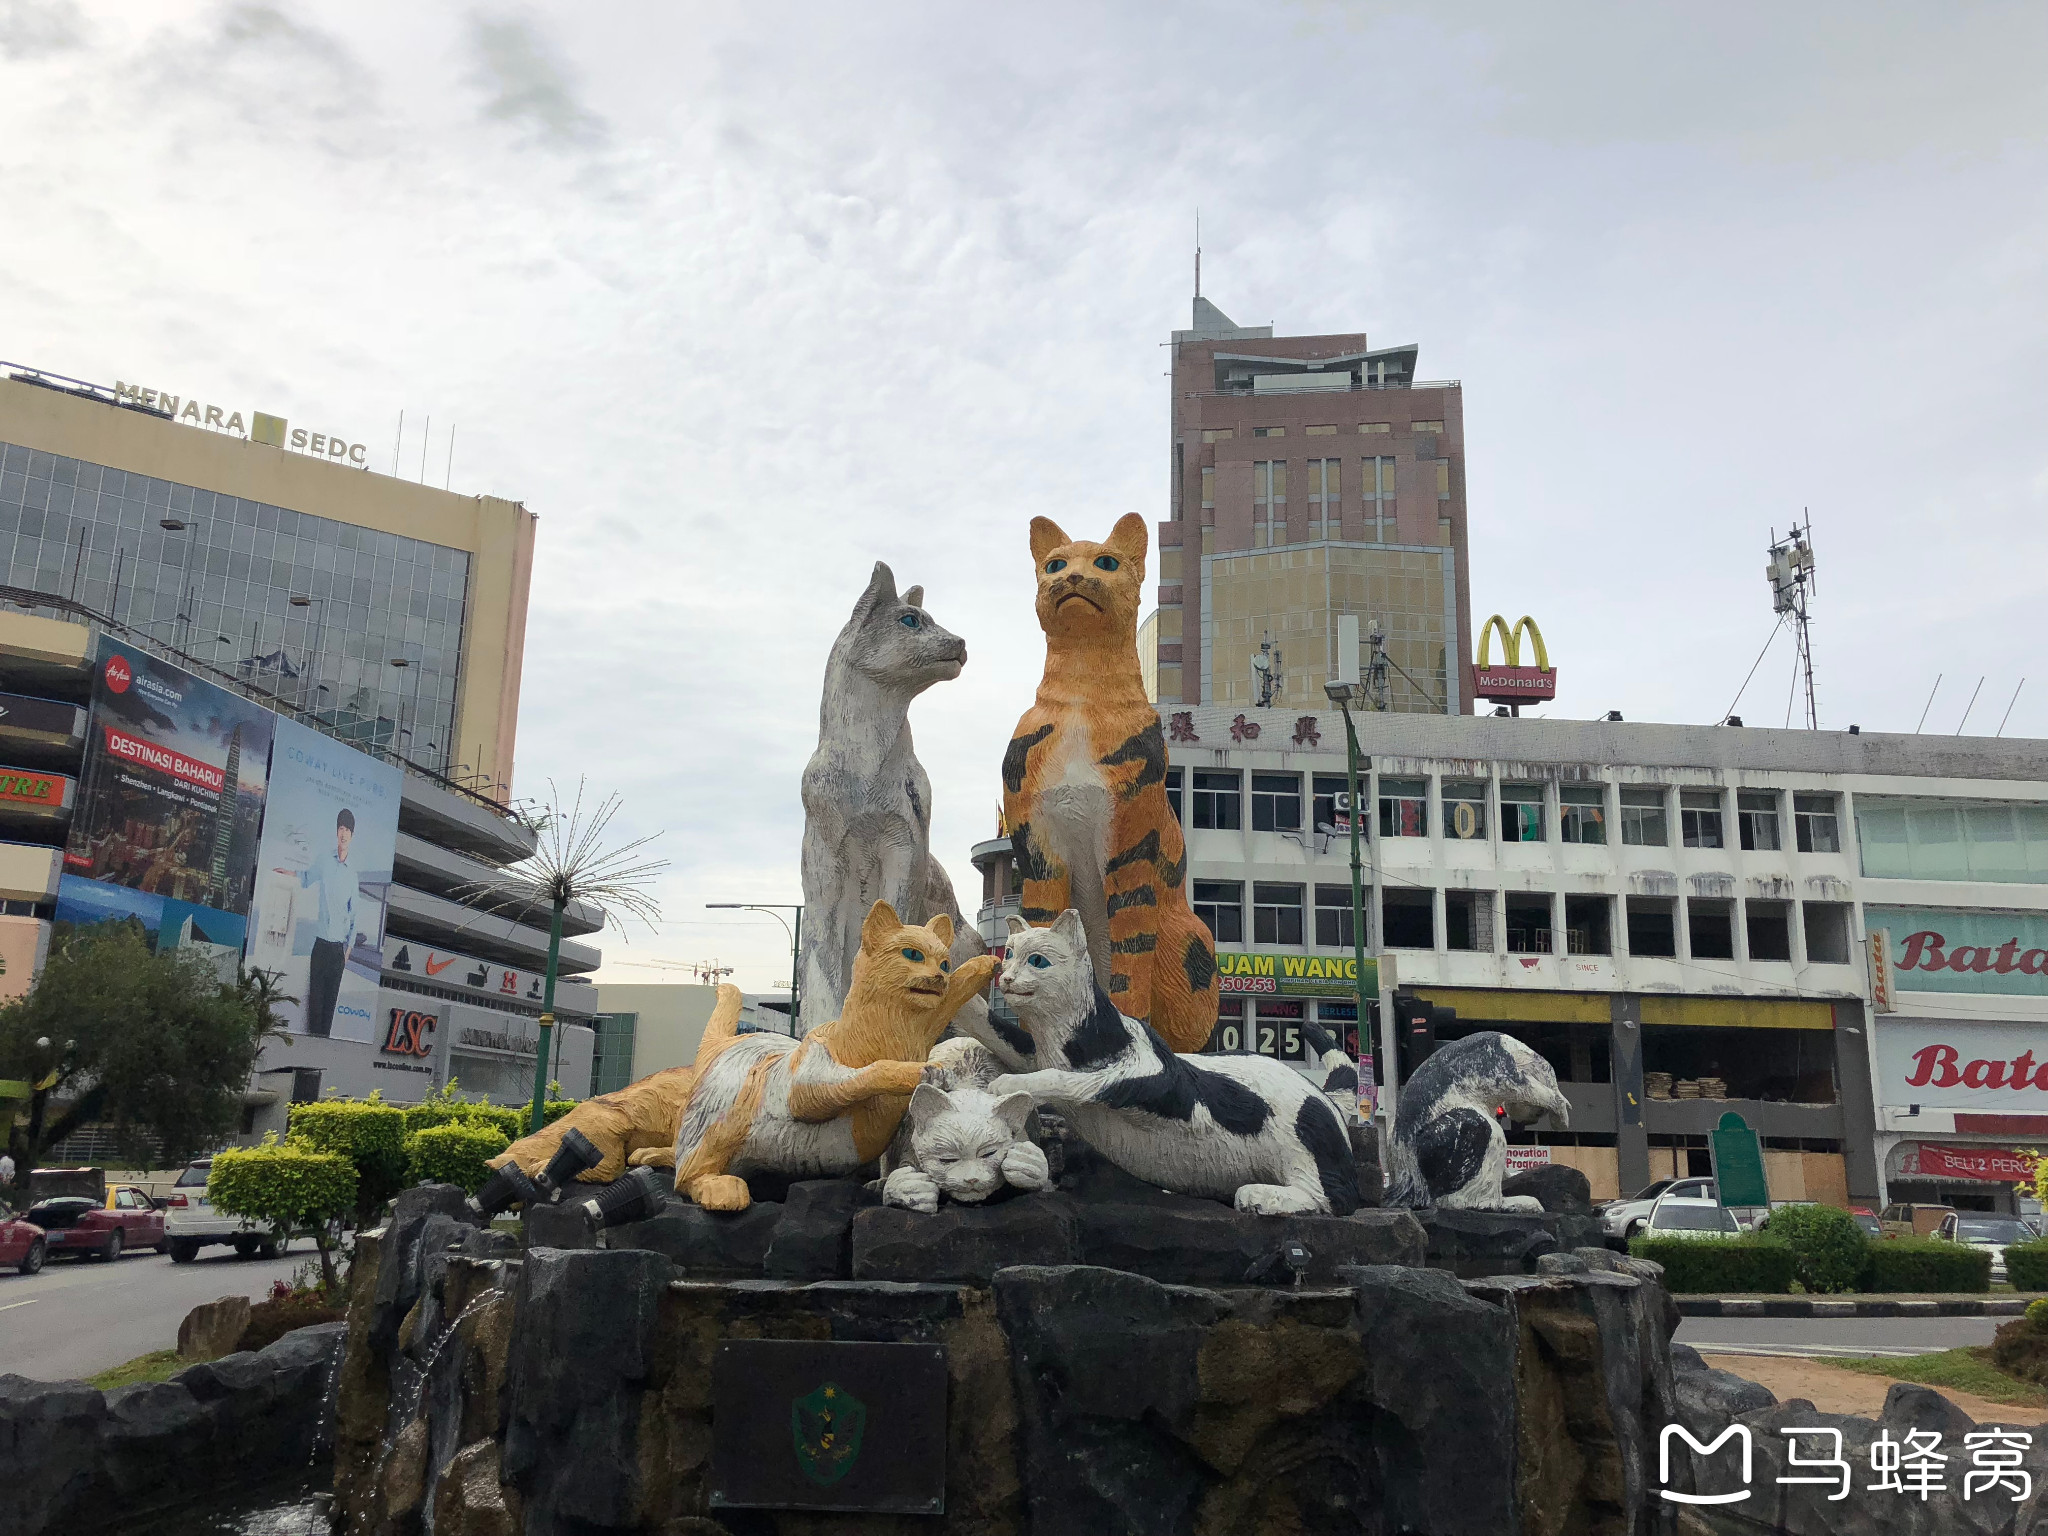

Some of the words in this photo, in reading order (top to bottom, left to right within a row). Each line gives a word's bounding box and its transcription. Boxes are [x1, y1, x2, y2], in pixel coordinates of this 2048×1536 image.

[115, 381, 245, 433] MENARA
[291, 429, 366, 463] SEDC
[136, 675, 182, 702] airasia.com
[1480, 676, 1553, 689] McDonald's
[111, 735, 173, 770] DESTINASI
[174, 758, 223, 788] BAHARU!
[120, 774, 152, 791] Shenzhen
[157, 786, 186, 803] Langkawi
[190, 798, 218, 813] Pontianak
[174, 778, 190, 791] DARI
[191, 783, 220, 801] KUCHING
[1216, 955, 1275, 976] JAM
[1282, 957, 1358, 979] WANG
[1894, 931, 2048, 976] Bata
[1576, 964, 1599, 972] SINCE
[1873, 934, 1887, 1007] Bata
[381, 1008, 438, 1058] LSC
[373, 1061, 433, 1076] www.lsconline.com.my
[1944, 1155, 1974, 1170] BELI
[1978, 1159, 1987, 1171] 2
